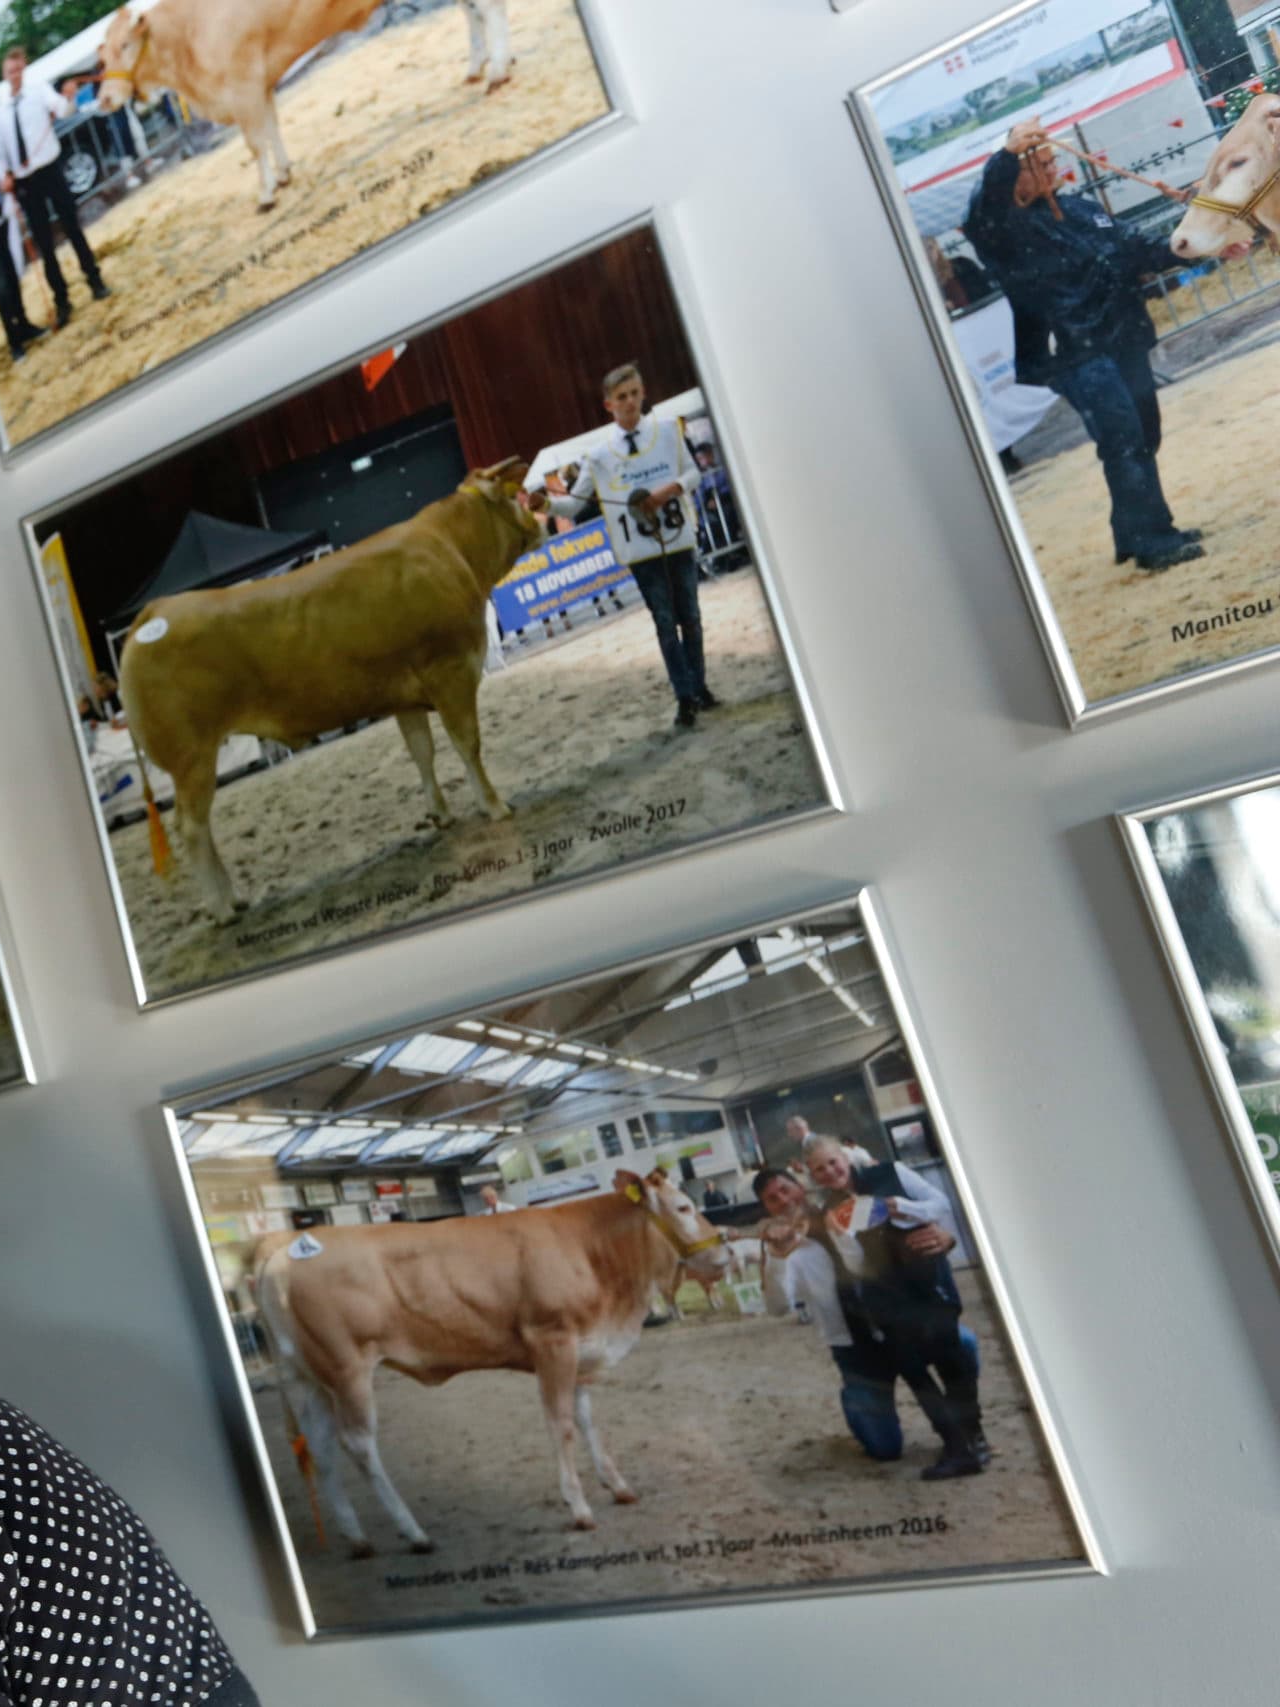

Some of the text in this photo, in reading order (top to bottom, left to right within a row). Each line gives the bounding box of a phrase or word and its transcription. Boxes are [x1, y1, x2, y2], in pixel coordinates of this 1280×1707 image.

[536, 549, 617, 596] NOVEMBER
[1171, 598, 1273, 643] Manitou
[589, 813, 642, 842] Zwolle
[646, 798, 687, 825] 2017
[898, 1513, 949, 1537] 2016
